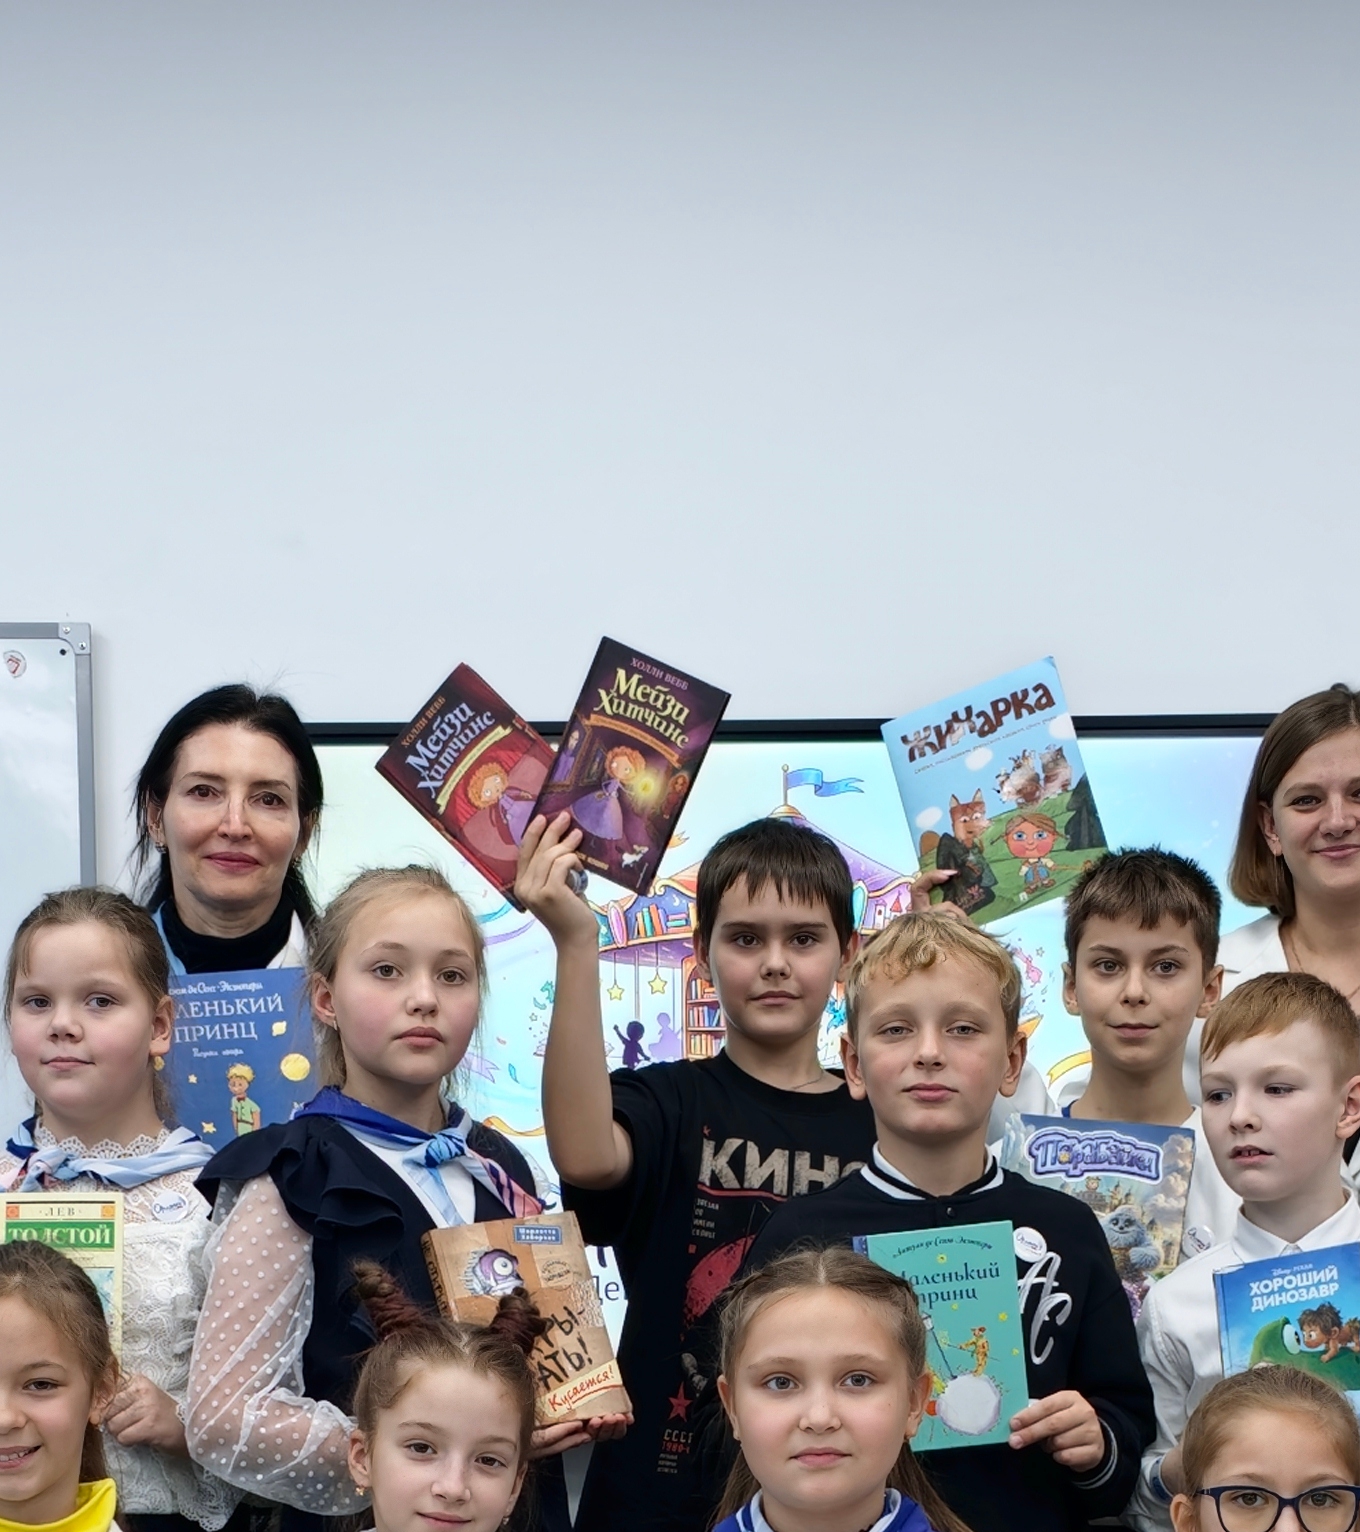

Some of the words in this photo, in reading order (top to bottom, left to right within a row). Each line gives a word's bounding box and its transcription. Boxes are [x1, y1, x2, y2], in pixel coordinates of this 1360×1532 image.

[665, 672, 689, 691] ВЕББ
[611, 668, 690, 726] Мейзи
[594, 688, 690, 749] Хитчинс
[405, 702, 476, 767] Мейзи
[417, 711, 495, 799] Хитчинс
[175, 993, 284, 1020] ЛЕНЬКИЙ
[174, 1021, 258, 1043] ПРИНЦ
[44, 1207, 75, 1217] ЛЕВ
[8, 1224, 111, 1244] ТОЛСТОЙ
[902, 1262, 1000, 1286] аленький
[1249, 1265, 1338, 1296] ХОРОШИЙ
[1251, 1282, 1339, 1312] ДИНОЗАВР
[539, 1332, 593, 1391] АТЬ!
[548, 1365, 615, 1412] Кусается!
